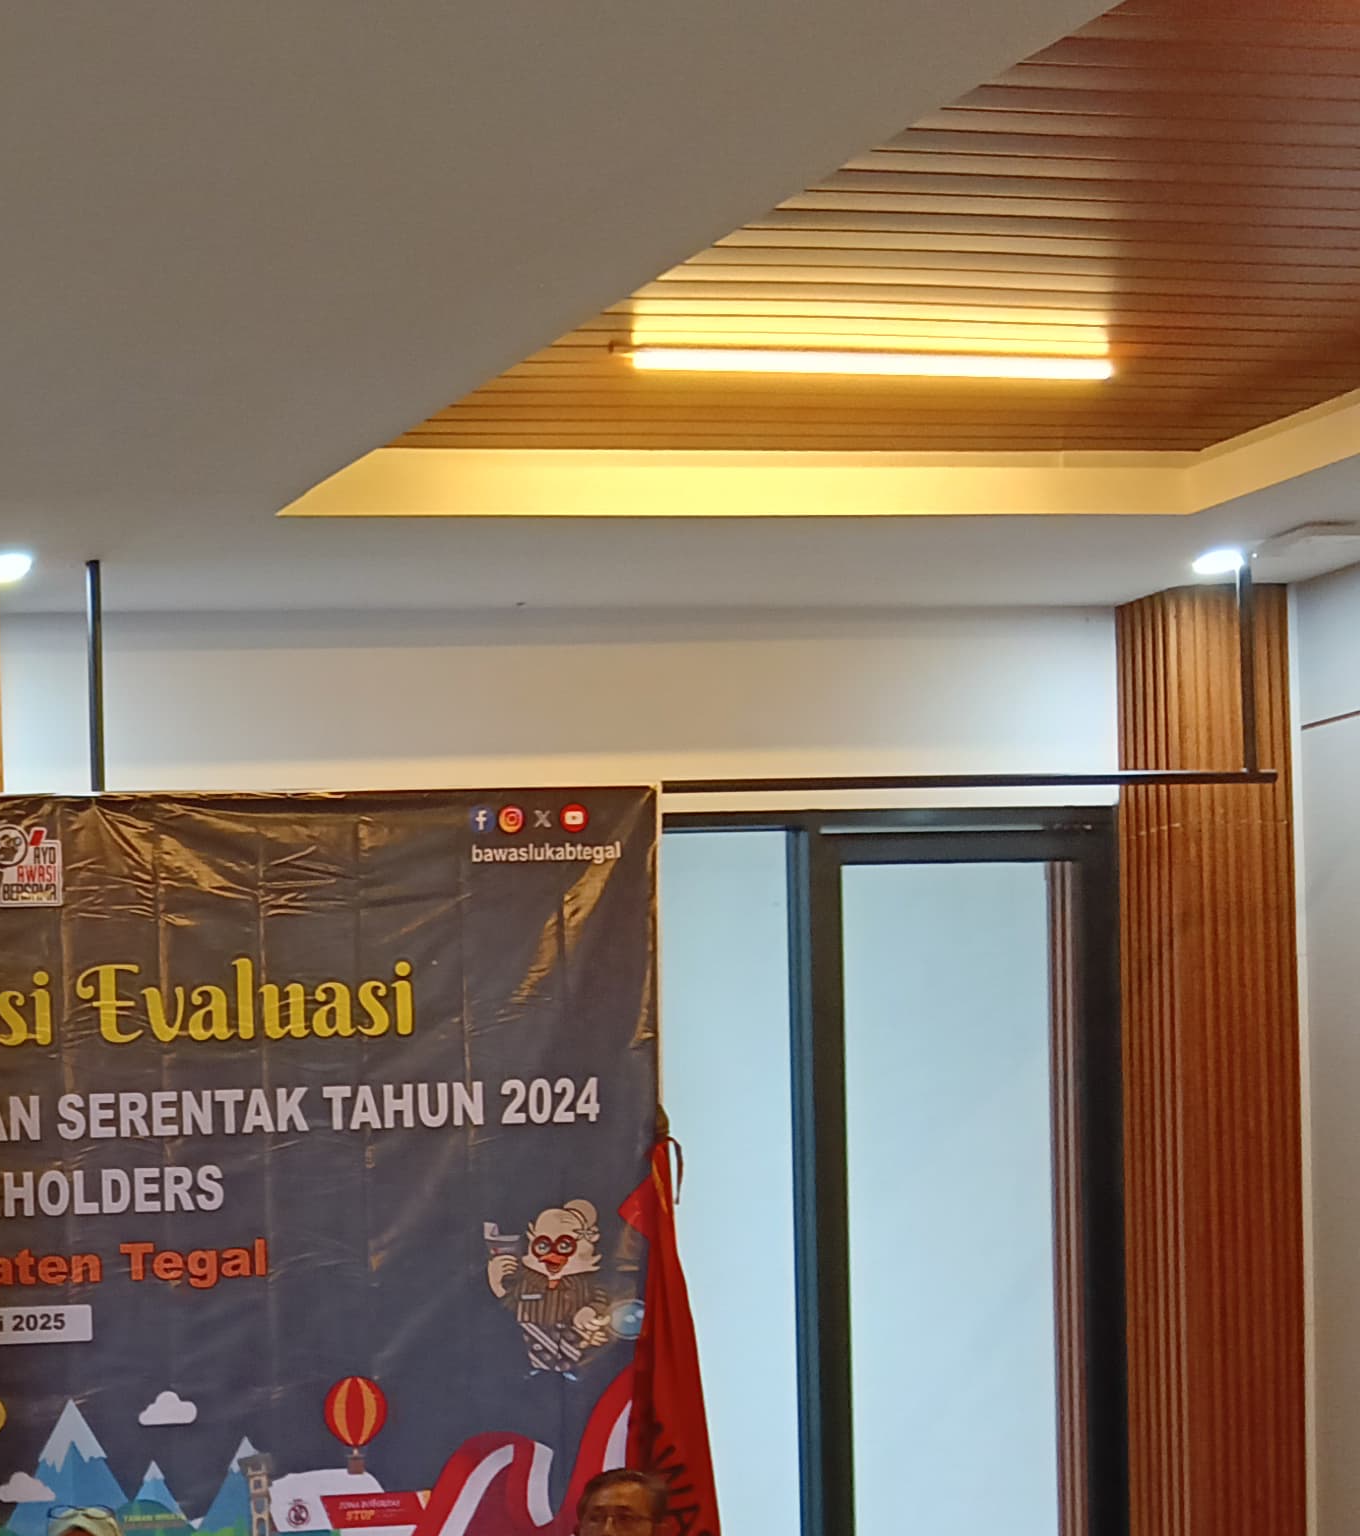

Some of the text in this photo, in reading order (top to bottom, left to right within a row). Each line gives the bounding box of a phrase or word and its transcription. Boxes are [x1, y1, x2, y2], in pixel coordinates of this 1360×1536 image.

[33, 847, 57, 865] AYO
[471, 841, 621, 864] bawaslukabtegal
[17, 865, 57, 882] AWASI
[75, 957, 416, 1047] Evaluasi
[56, 1085, 308, 1141] SERENTAK
[322, 1081, 484, 1131] TAHUN
[500, 1077, 601, 1126] 2024
[119, 1237, 269, 1289] Tegal
[11, 1313, 66, 1333] 2025
